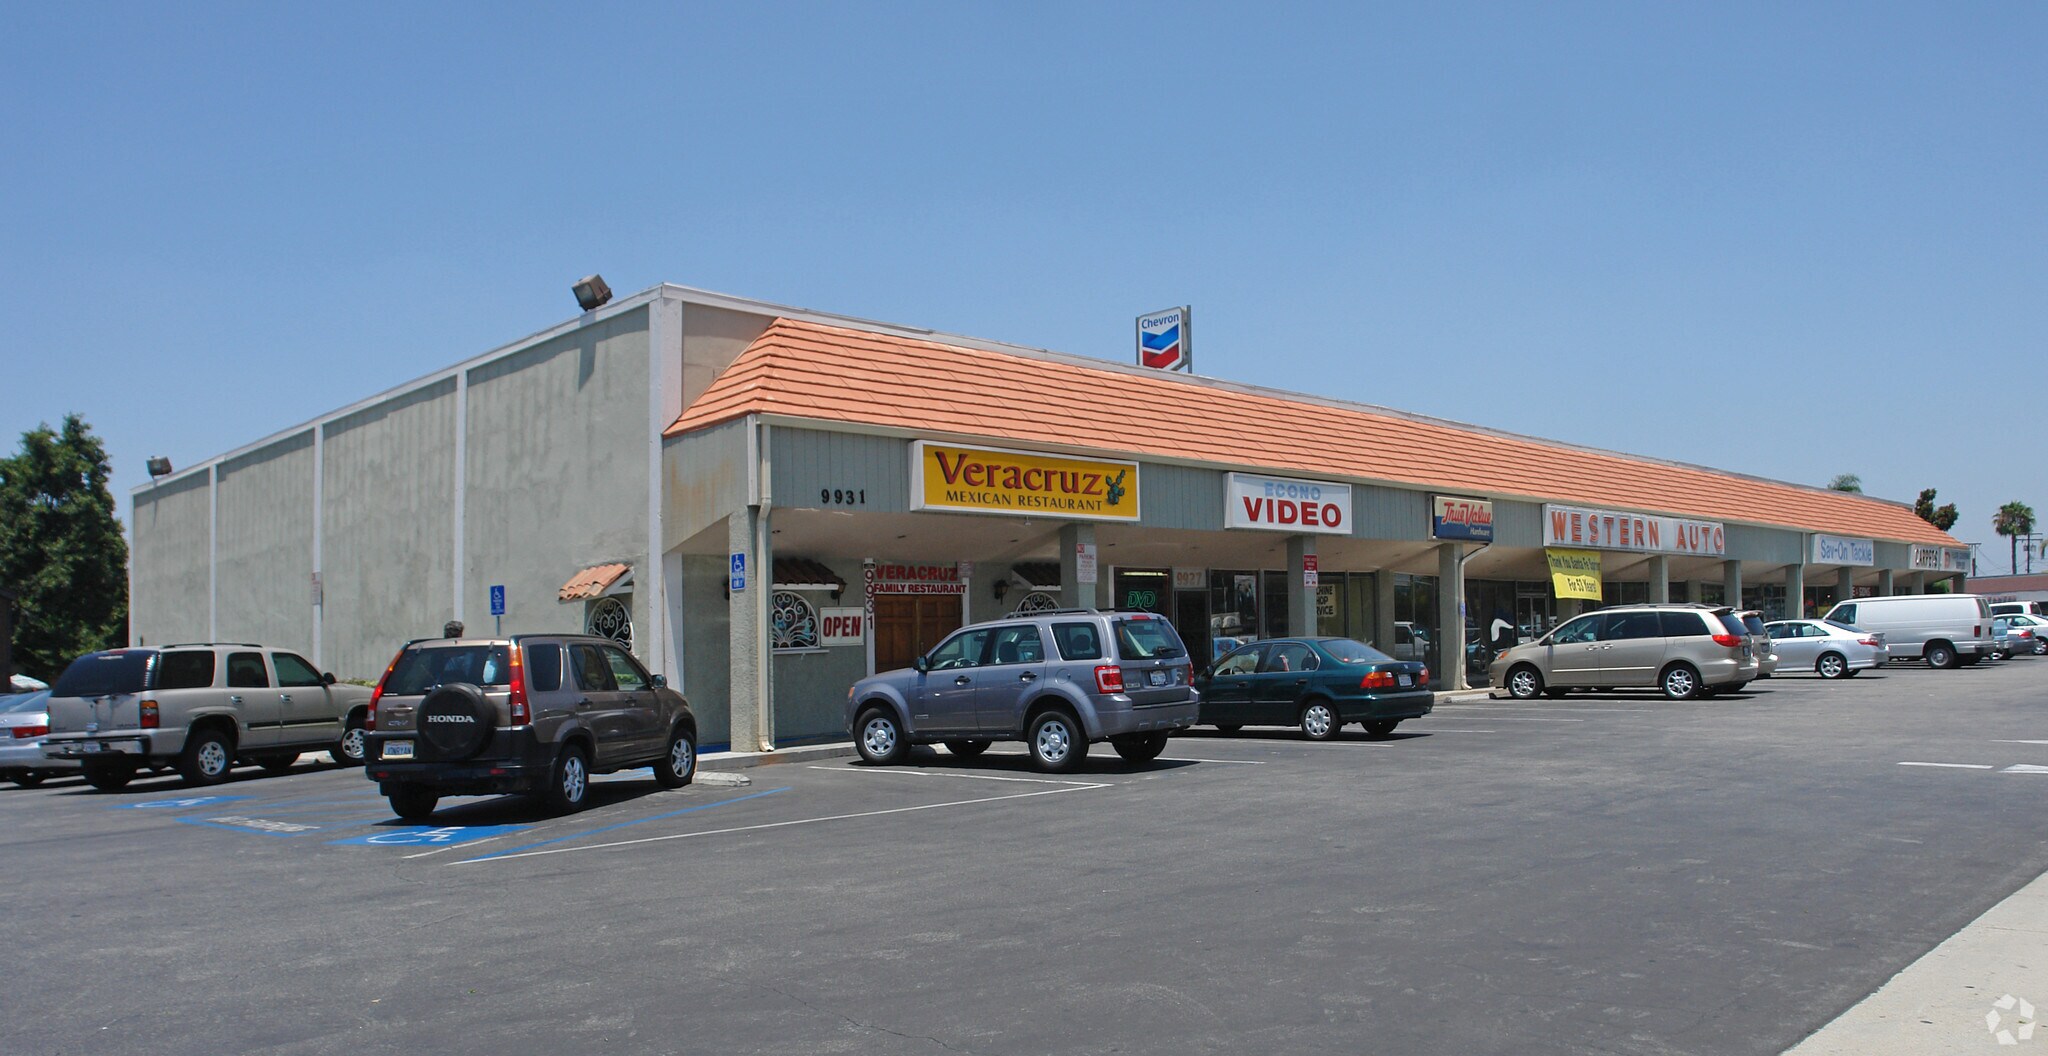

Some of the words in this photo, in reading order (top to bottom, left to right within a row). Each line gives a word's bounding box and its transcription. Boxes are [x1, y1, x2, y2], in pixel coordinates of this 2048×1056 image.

[1141, 314, 1179, 329] Chevron
[934, 451, 1102, 496] Veracruz
[821, 489, 865, 505] 9931
[1264, 482, 1321, 500] ECONO
[945, 490, 1011, 506] MEXICAN
[1018, 495, 1102, 511] RESTAURANT
[1242, 496, 1342, 528] VIDEO
[1551, 511, 1659, 546] WESTERN
[1676, 523, 1724, 551] AUTO
[1820, 538, 1849, 561] Sav-On
[1851, 542, 1873, 563] Tackle
[1914, 548, 1938, 568] CARPETS
[875, 565, 958, 581] VERACRUZ
[1176, 572, 1202, 586] 9927
[874, 583, 906, 593] FAMILY
[908, 584, 967, 594] RESTAURANT
[1316, 586, 1333, 596] CHINE
[1567, 578, 1577, 592] For
[1575, 578, 1584, 592] 53
[1127, 590, 1156, 608] DVD
[1316, 596, 1329, 605] HOP
[1316, 605, 1334, 616] RVICE
[823, 616, 862, 637] OPEN
[427, 715, 475, 723] HONDA
